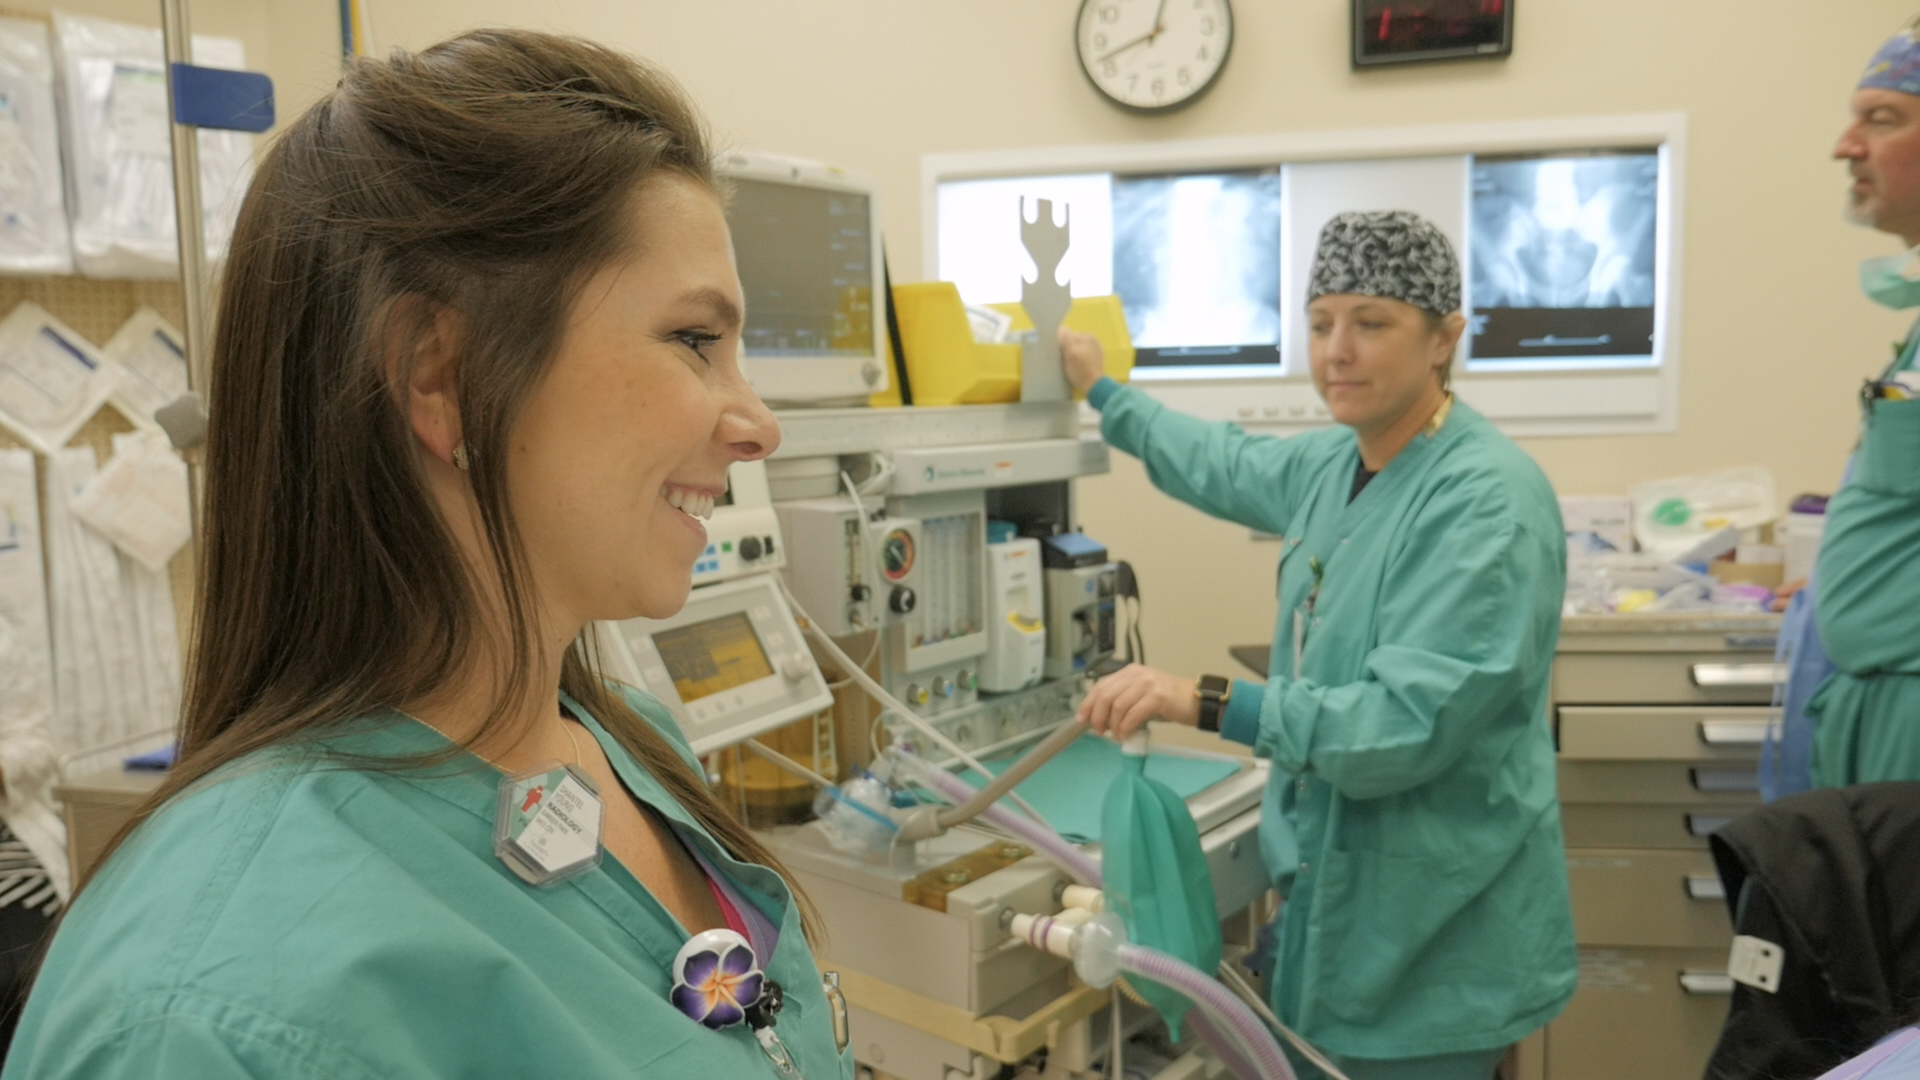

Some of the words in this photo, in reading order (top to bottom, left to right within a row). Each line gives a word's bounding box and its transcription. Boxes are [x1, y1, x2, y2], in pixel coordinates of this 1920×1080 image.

[1099, 5, 1119, 25] 10
[1200, 15, 1214, 37] 3
[1093, 31, 1107, 50] 9
[1196, 45, 1208, 62] 4
[1102, 58, 1117, 79] 8
[1177, 65, 1190, 86] 5
[1128, 72, 1139, 93] 7
[1150, 78, 1165, 98] 6
[553, 792, 574, 812] YOUNG
[546, 801, 582, 834] RADIOLOGY
